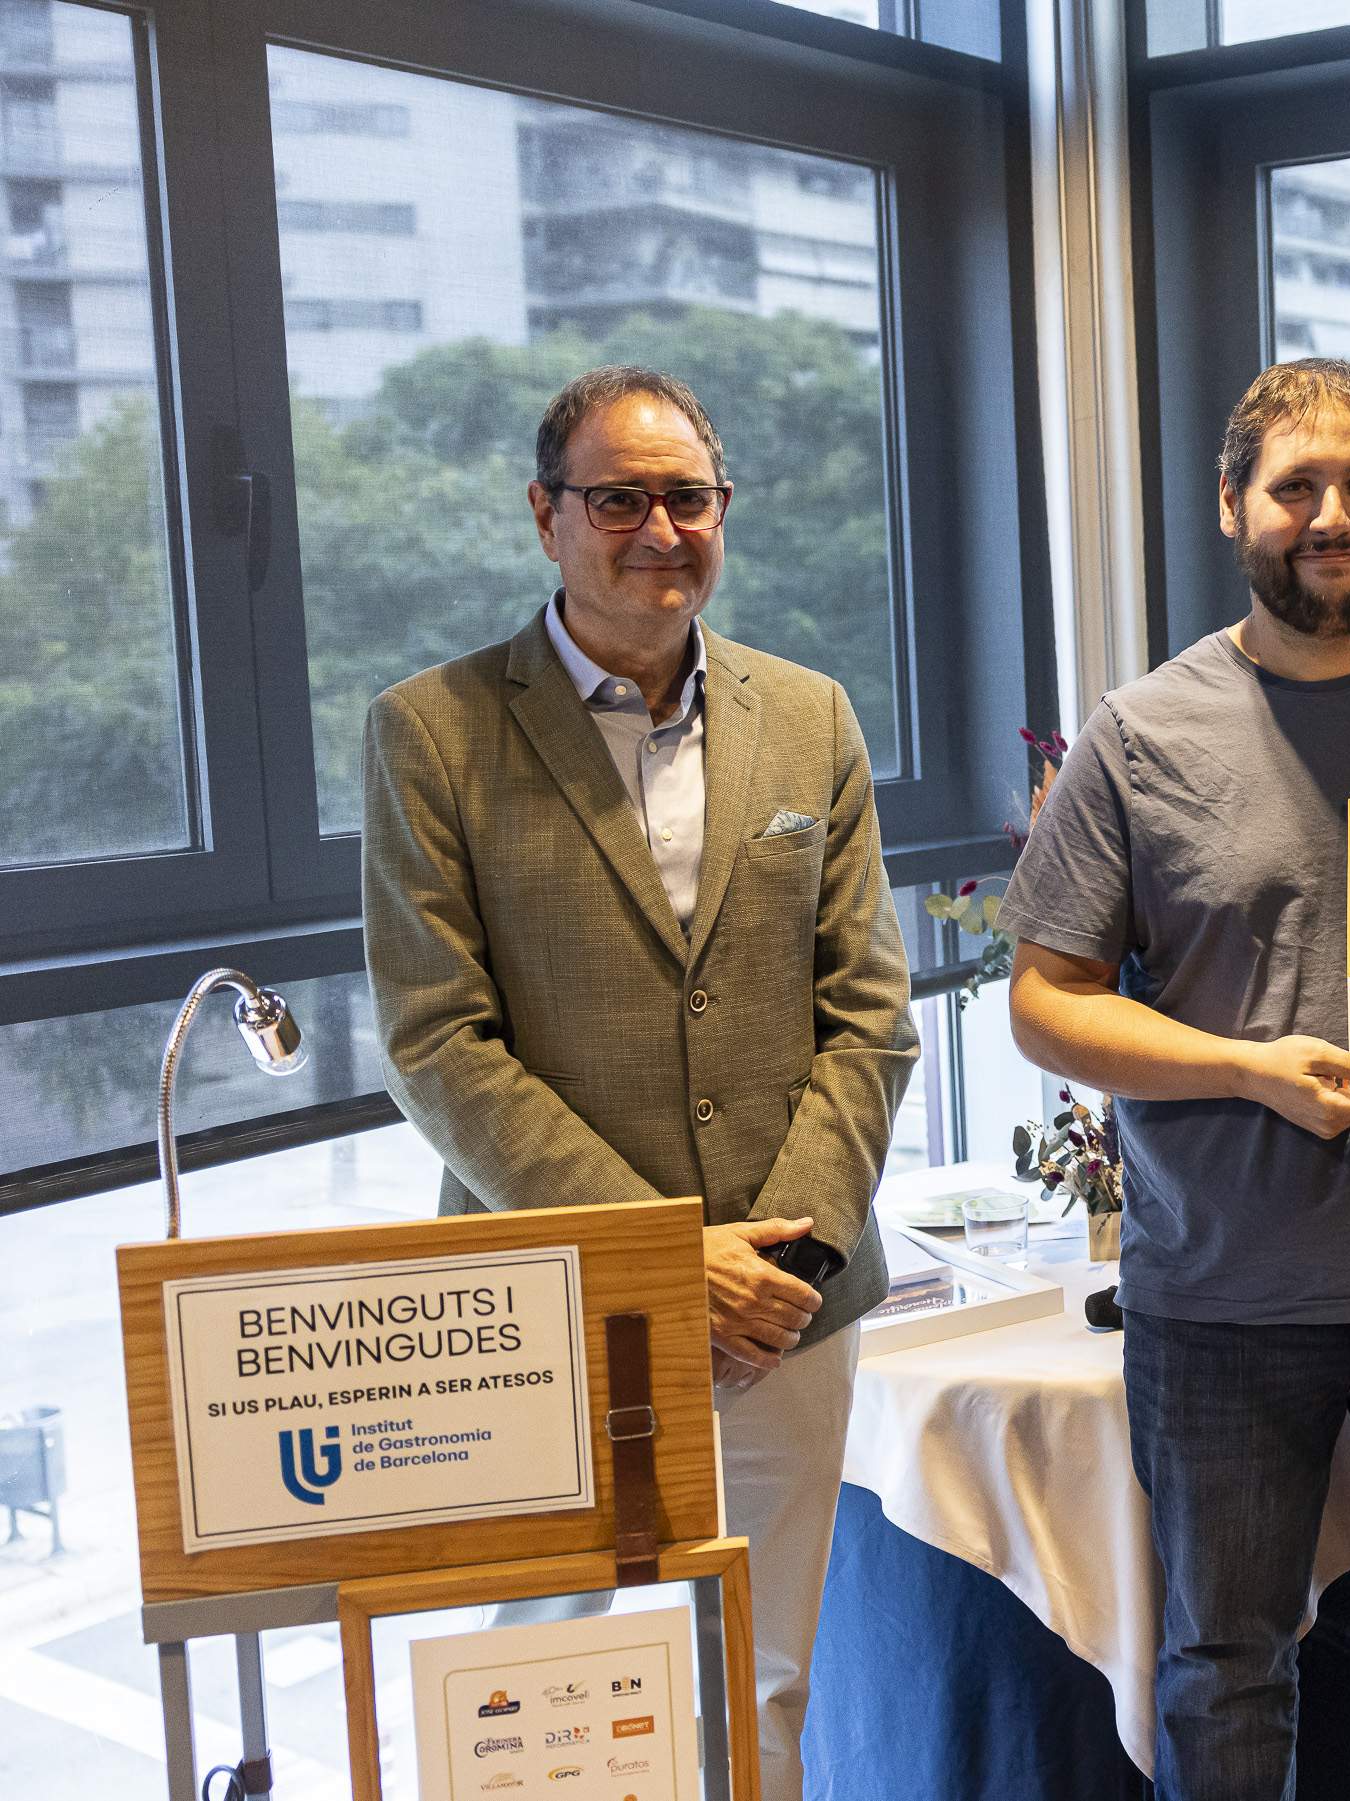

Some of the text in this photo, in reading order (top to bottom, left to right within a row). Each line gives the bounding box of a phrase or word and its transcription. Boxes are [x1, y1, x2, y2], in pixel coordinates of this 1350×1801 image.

[239, 1286, 513, 1339] BENVINGUTS I
[236, 1323, 522, 1377] BENVINGUDES
[208, 1370, 554, 1417] SI US PLAU, ESPERIN A SER ATESOS
[351, 1418, 413, 1436] Institut
[352, 1428, 492, 1454] de Gastronomia
[354, 1449, 469, 1472] de Barcelona
[474, 1741, 524, 1758] COROMINA
